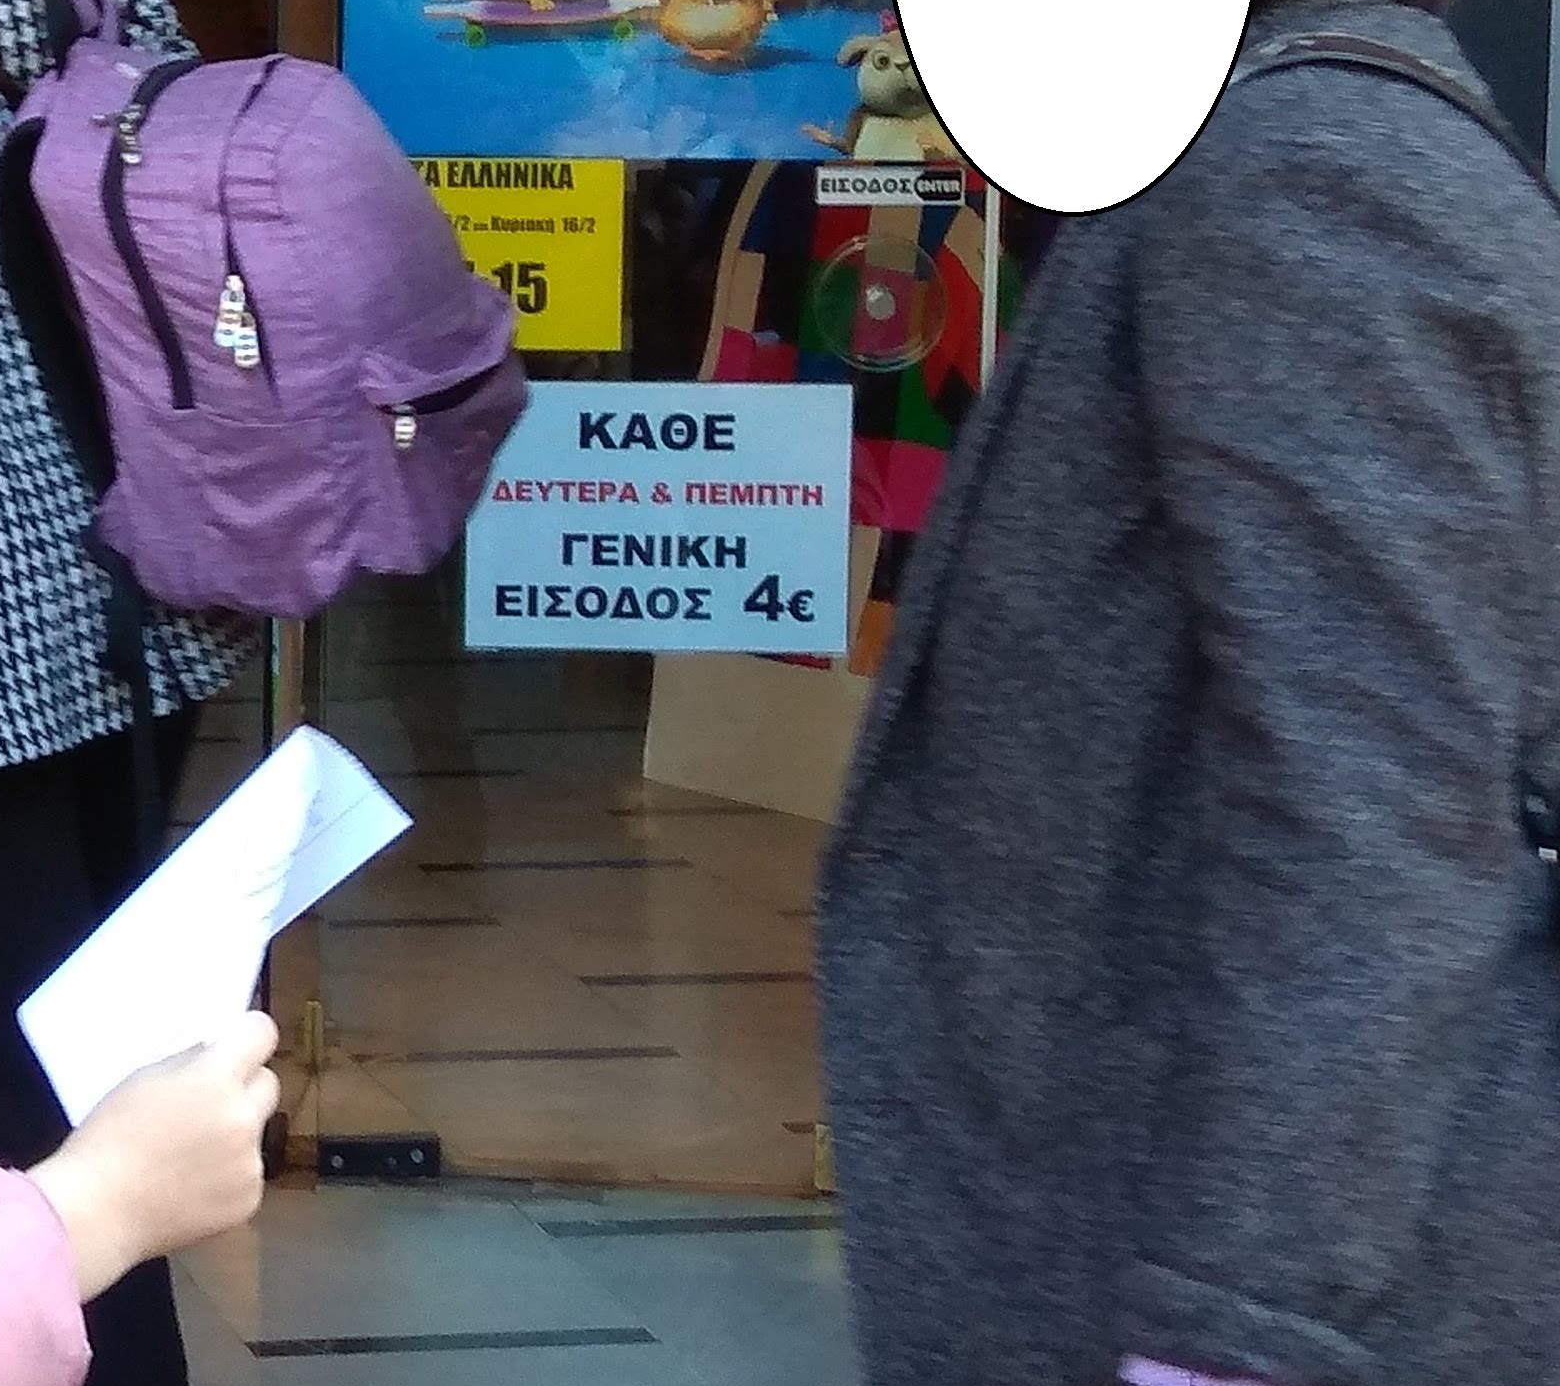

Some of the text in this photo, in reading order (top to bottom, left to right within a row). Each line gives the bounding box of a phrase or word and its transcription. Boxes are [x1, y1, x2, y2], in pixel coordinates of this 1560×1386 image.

[821, 177, 912, 193] ΕΙΣΟΔΟΣ
[916, 179, 961, 193] ENTER
[578, 411, 736, 451] ΚΑΘΕ
[492, 479, 825, 506] ΔΕΥΤΕΡΑ & ΠΕΜΠΤΗ
[561, 533, 748, 569] ΓΕΝΙΚΗ
[495, 584, 712, 621] ΕΙΣΟΔΟΣ
